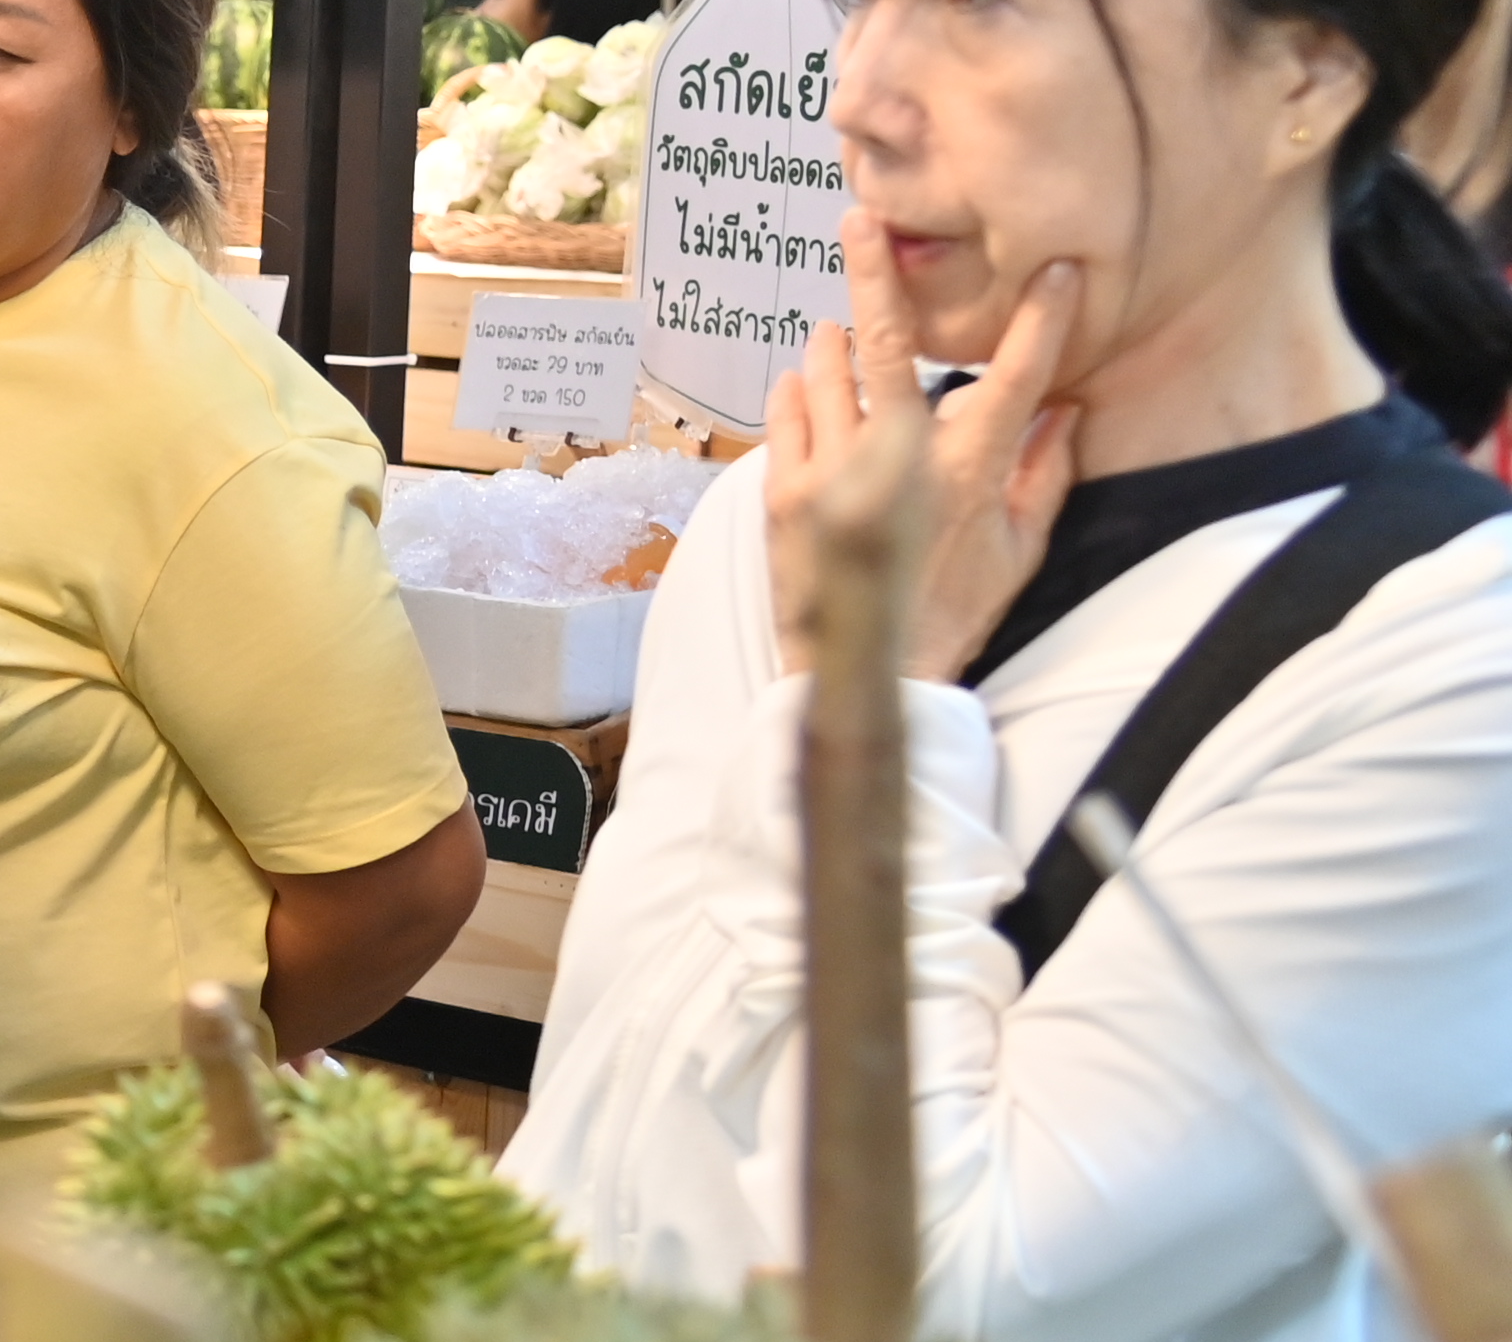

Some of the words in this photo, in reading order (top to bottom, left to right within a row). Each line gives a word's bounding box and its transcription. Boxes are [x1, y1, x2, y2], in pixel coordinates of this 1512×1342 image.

[679, 48, 839, 122] สกัดเย็
[657, 134, 843, 190] วัตถุดิบปลอดส
[475, 320, 567, 343] ปลอดสารพิษ
[575, 360, 604, 376] บาท
[503, 384, 514, 402] 2
[556, 388, 586, 407] 150
